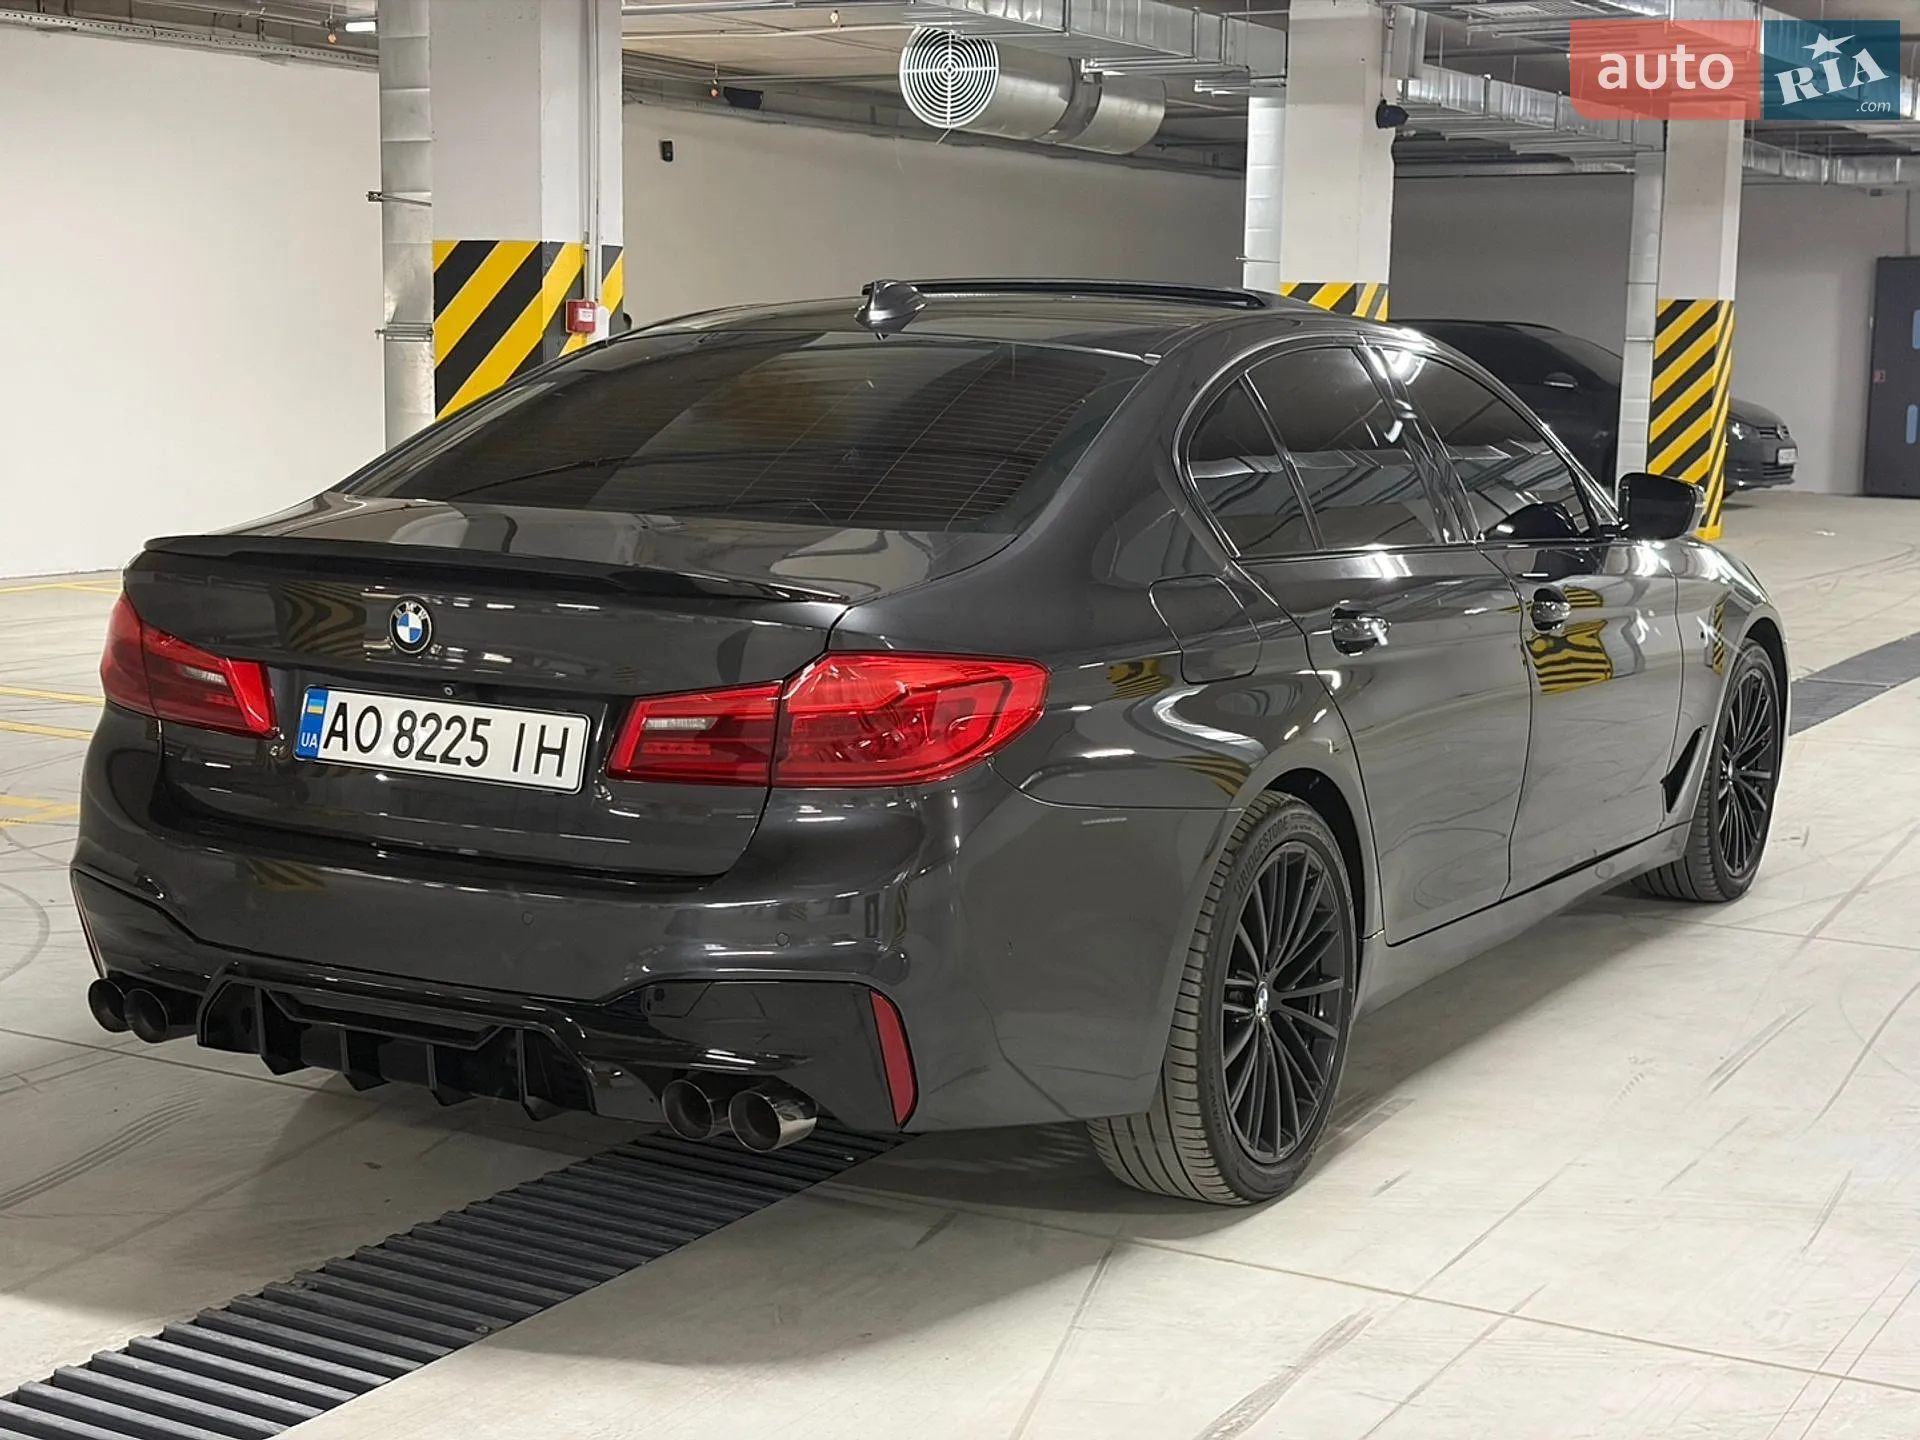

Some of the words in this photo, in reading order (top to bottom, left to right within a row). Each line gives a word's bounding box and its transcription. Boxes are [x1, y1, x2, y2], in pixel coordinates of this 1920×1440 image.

[301, 732, 318, 749] UA
[323, 701, 383, 754] AO
[393, 709, 493, 768] 8225
[512, 722, 570, 779] IH
